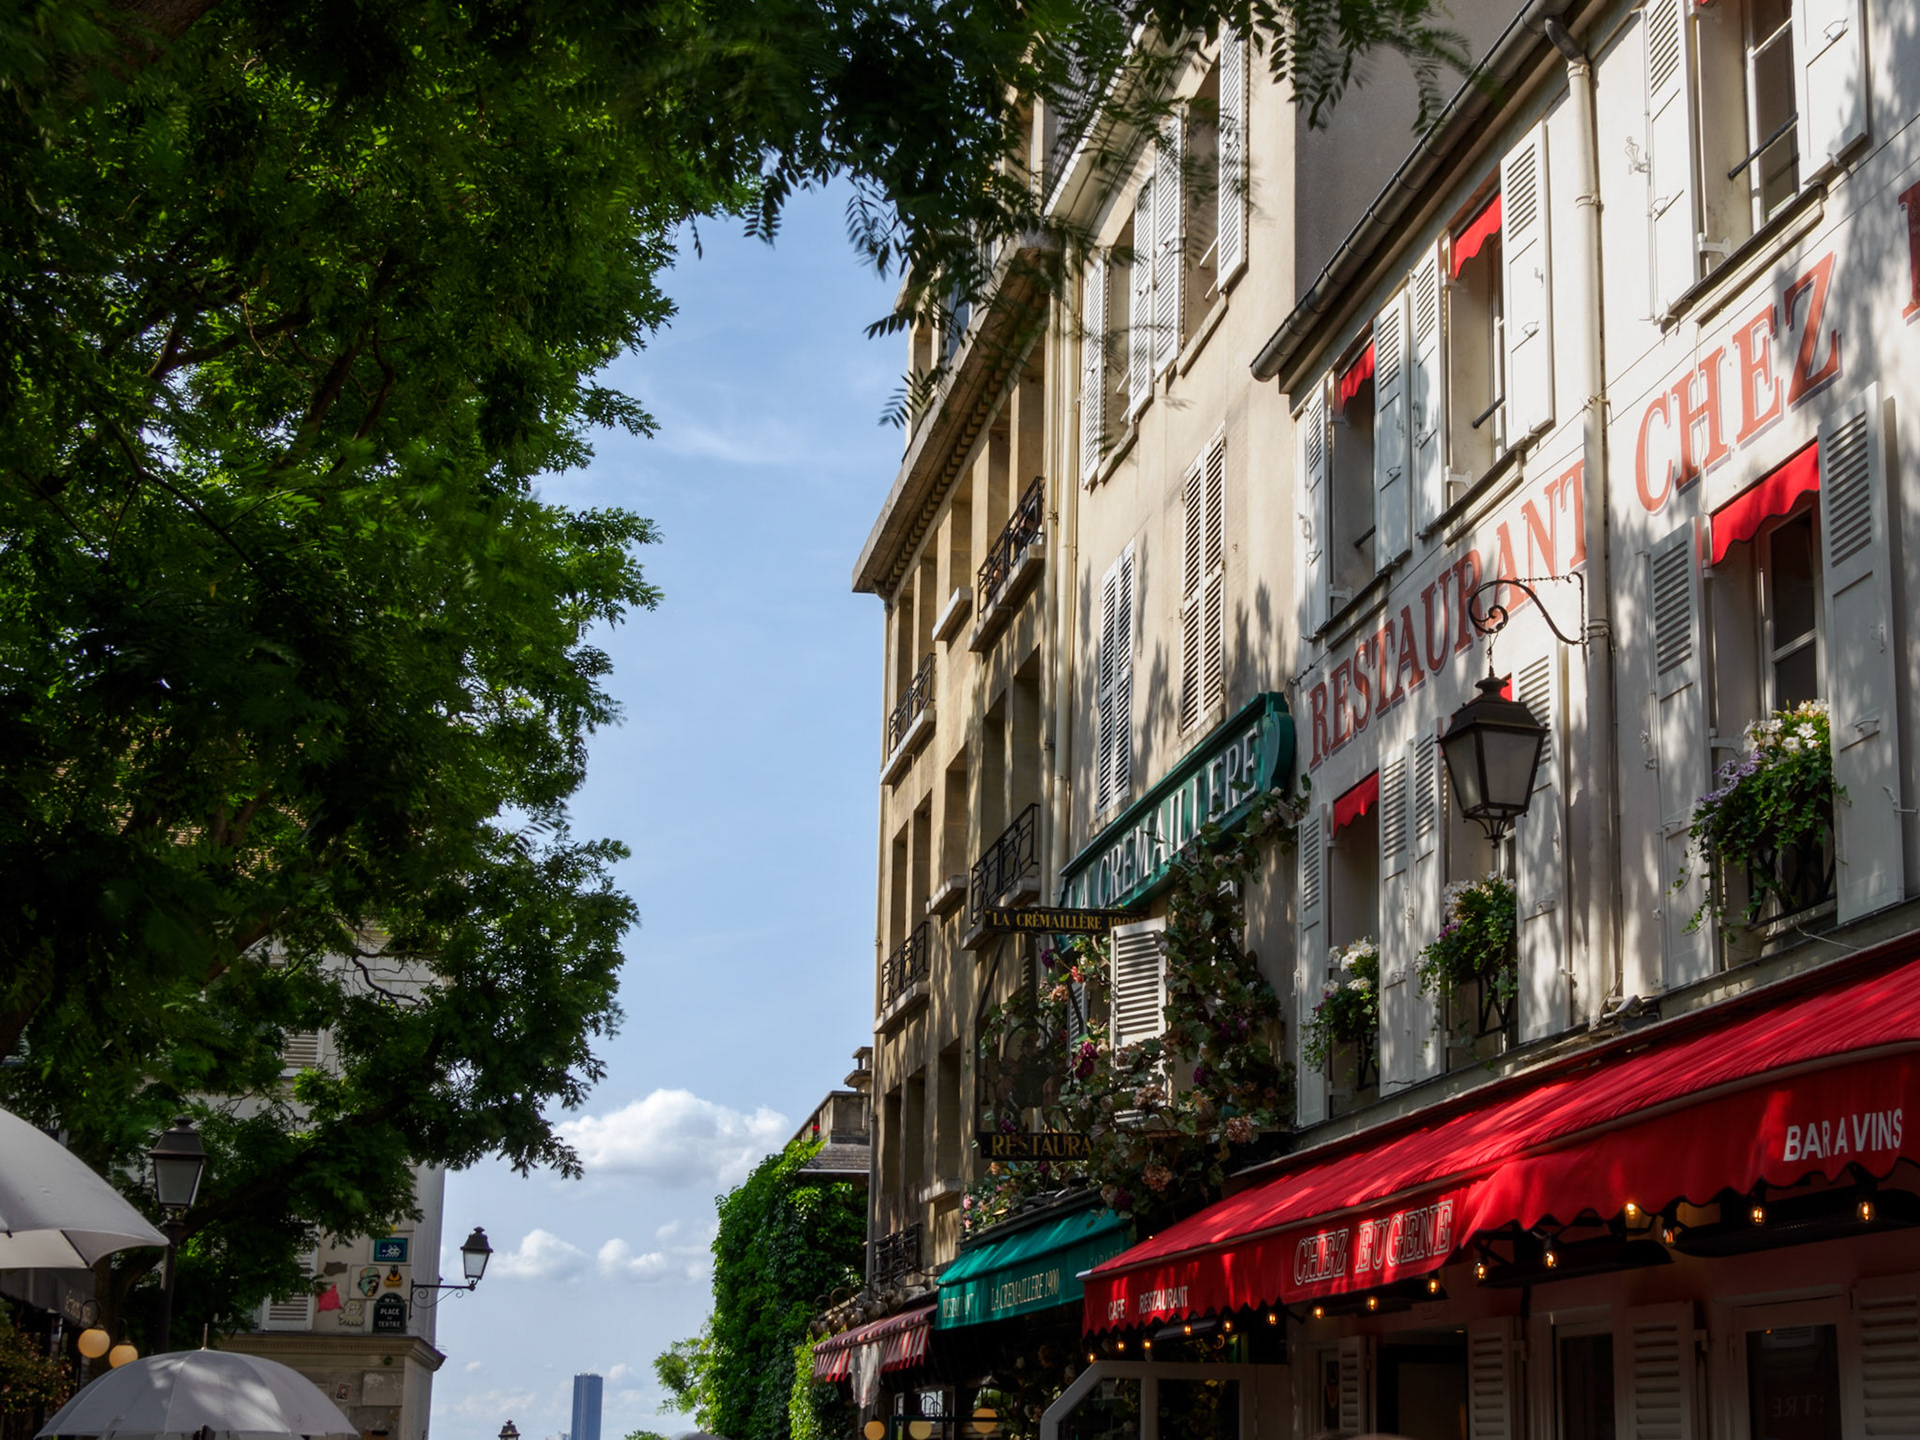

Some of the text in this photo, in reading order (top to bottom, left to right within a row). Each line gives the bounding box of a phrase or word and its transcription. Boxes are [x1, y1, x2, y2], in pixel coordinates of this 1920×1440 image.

[1635, 251, 1842, 515] CHEZ
[1309, 459, 1587, 772] RESTAURANT
[1016, 911, 1102, 930] CRÉMAILLÈRE
[1783, 1108, 1902, 1162] BAR A VINS
[1293, 1199, 1453, 1286] CHEZ EUGENE
[1108, 1285, 1188, 1320] CAFE RESTAURANT
